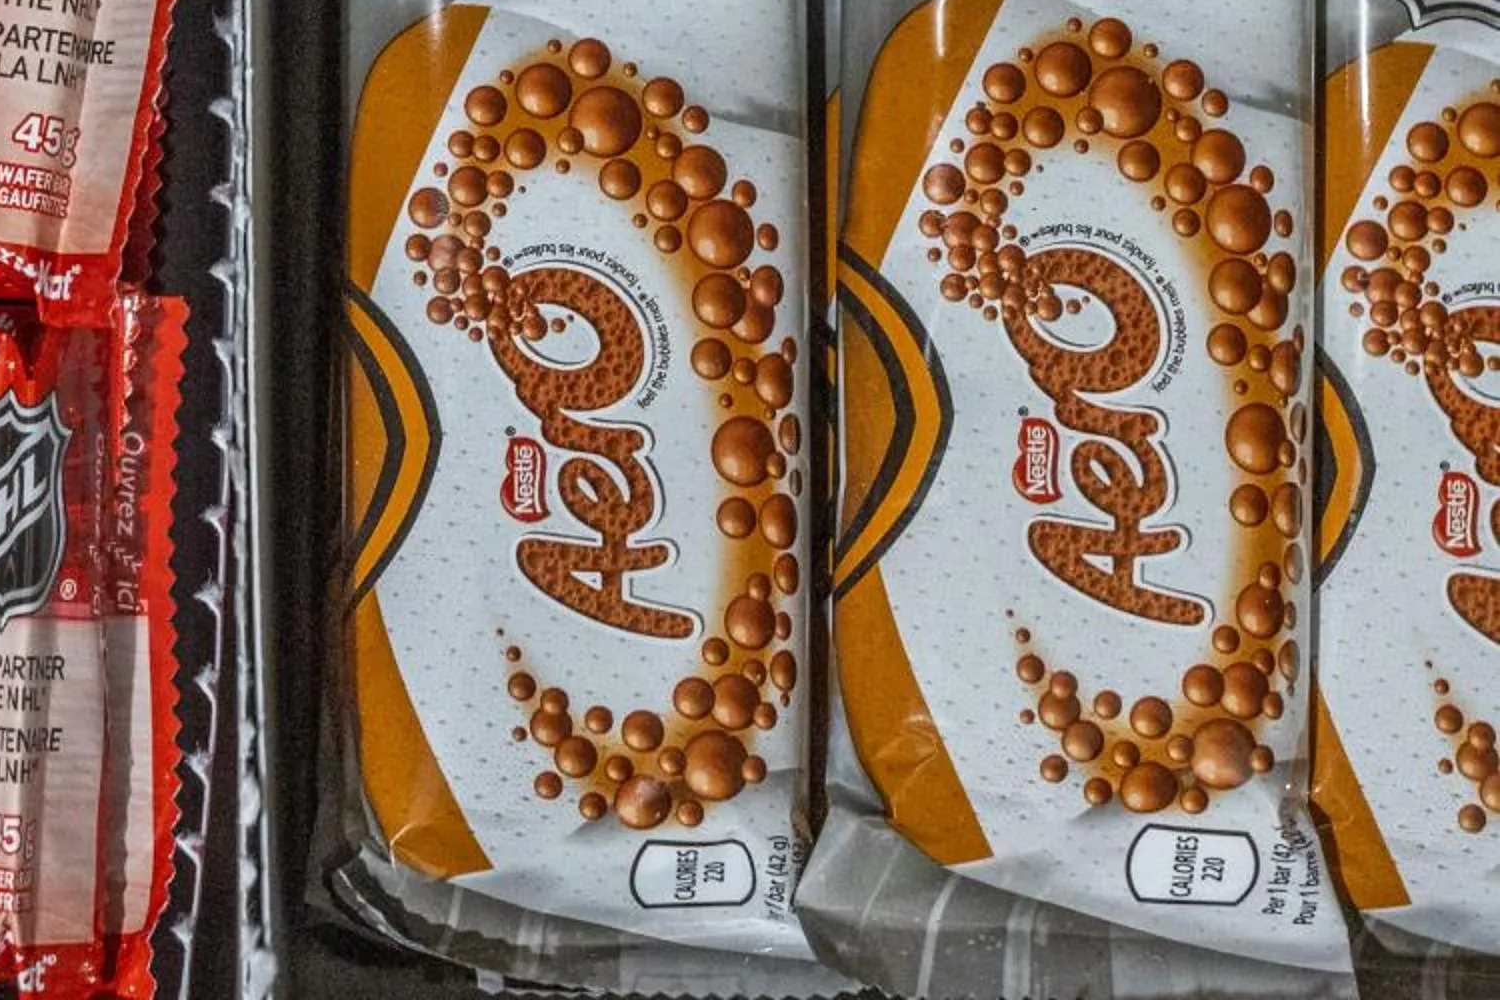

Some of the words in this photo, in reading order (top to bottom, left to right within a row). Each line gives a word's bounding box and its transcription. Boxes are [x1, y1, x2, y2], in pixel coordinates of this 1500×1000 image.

[13, 113, 62, 156] 45
[1092, 227, 1124, 245] pour
[575, 246, 607, 262] pour
[604, 255, 639, 288] fondez
[655, 323, 671, 370] bubbles
[1172, 308, 1187, 355] bubbles
[651, 372, 668, 389] the
[486, 266, 696, 639] Aero
[1001, 246, 1205, 626] Aero
[117, 431, 145, 536] Ouvrez
[673, 849, 699, 901] CALORIES
[703, 860, 725, 883] 220
[1169, 835, 1199, 898] CALORIES
[1201, 857, 1226, 883] 220
[1267, 865, 1292, 885] bar
[1261, 896, 1286, 915] Per
[1292, 899, 1318, 926] Pour
